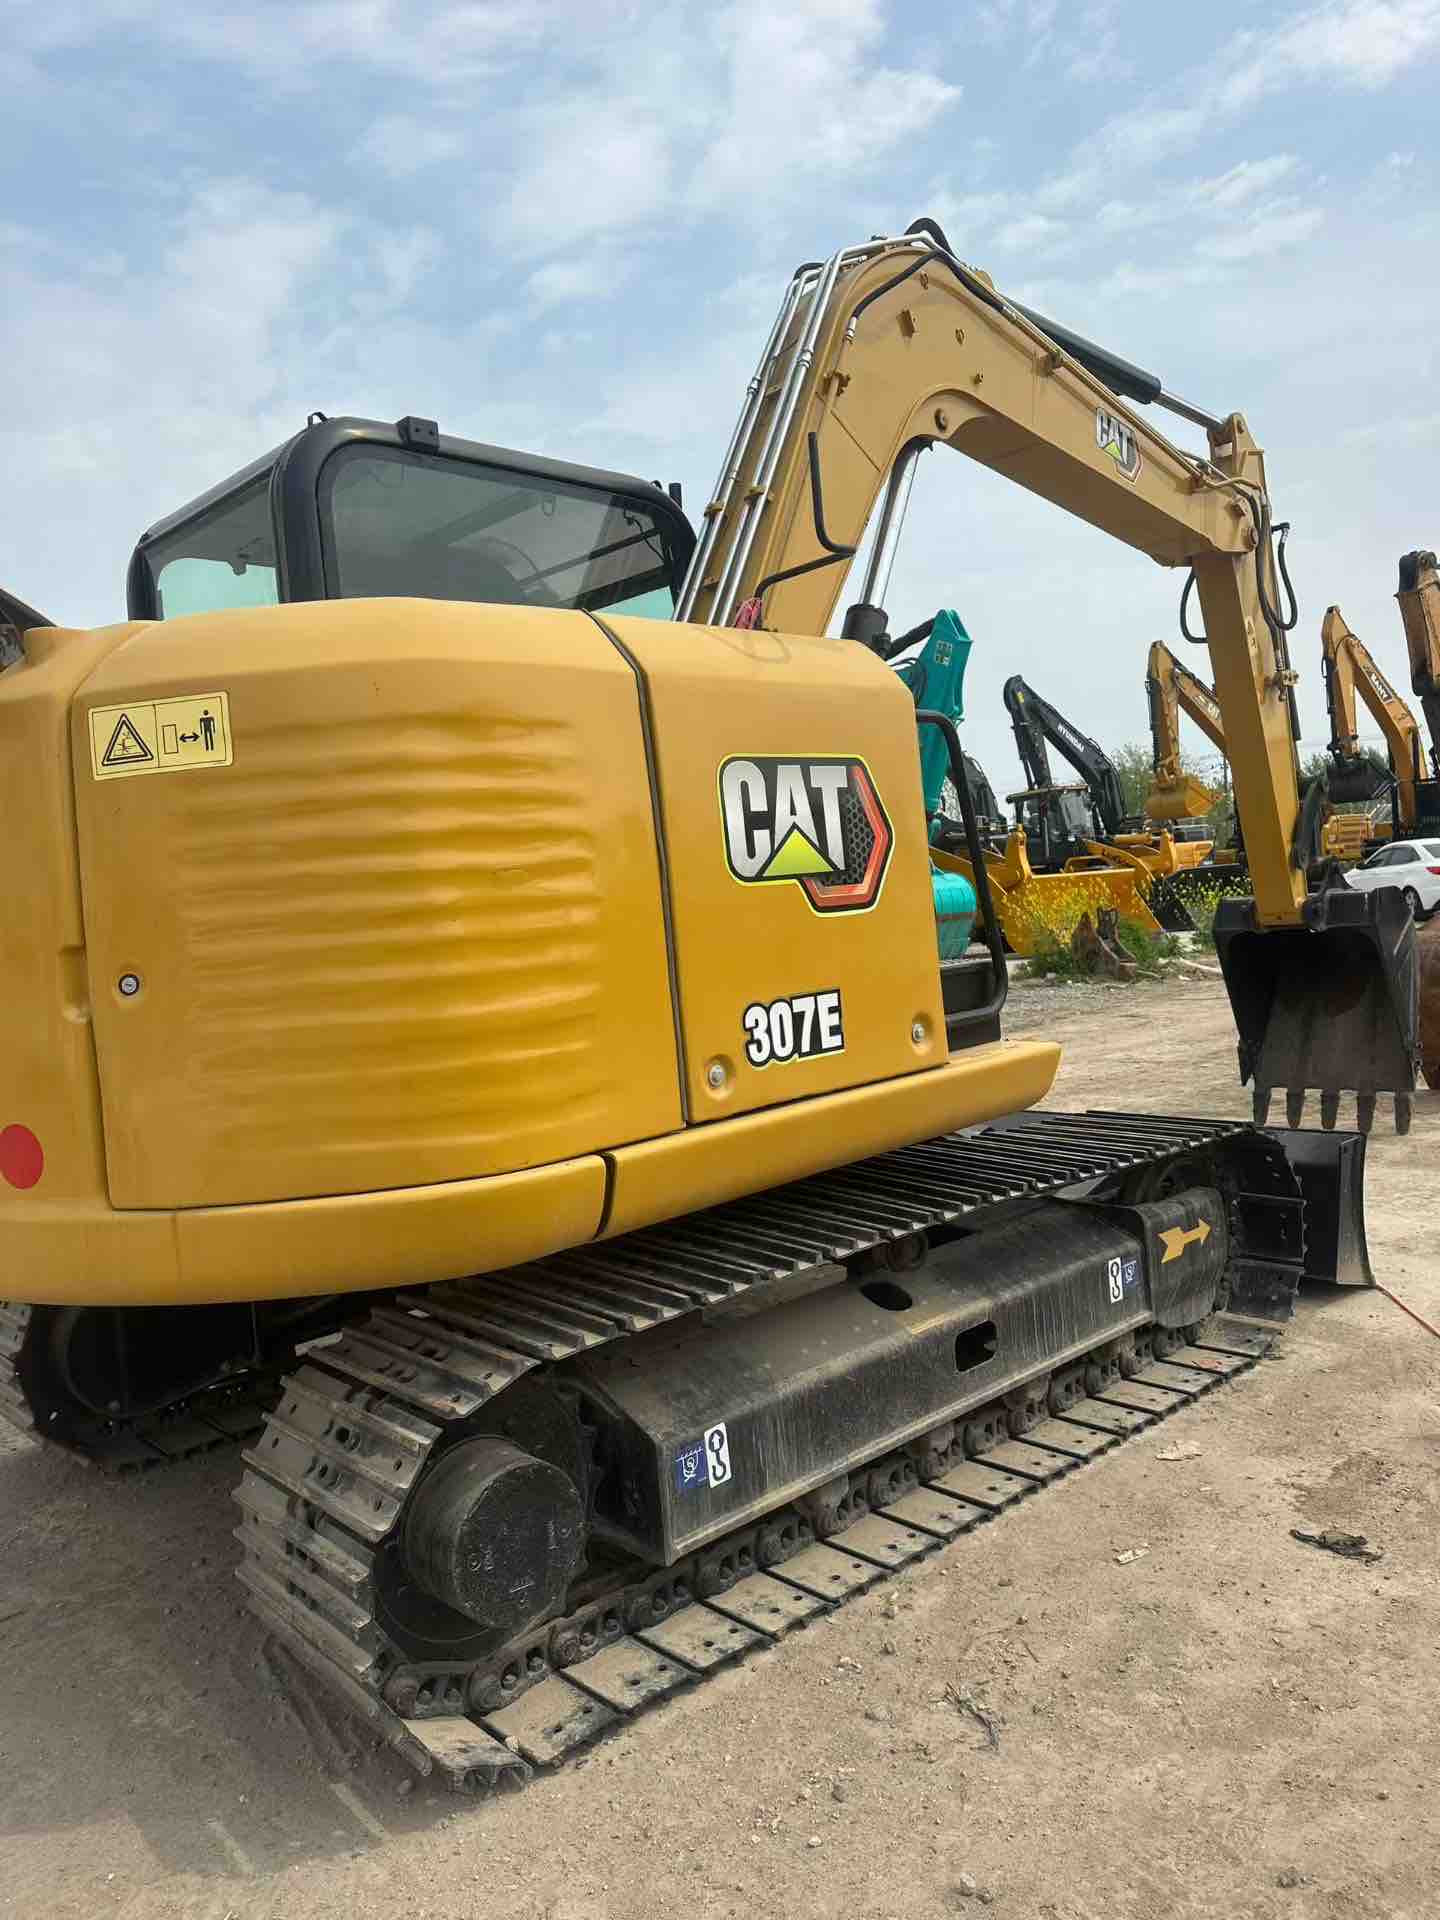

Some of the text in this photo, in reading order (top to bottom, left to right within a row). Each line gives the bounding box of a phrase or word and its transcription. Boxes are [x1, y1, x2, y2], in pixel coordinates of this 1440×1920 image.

[1096, 407, 1133, 464] CAT
[1056, 722, 1085, 752] HYUNDAI
[722, 760, 849, 877] CAT
[743, 991, 843, 1064] 307E
